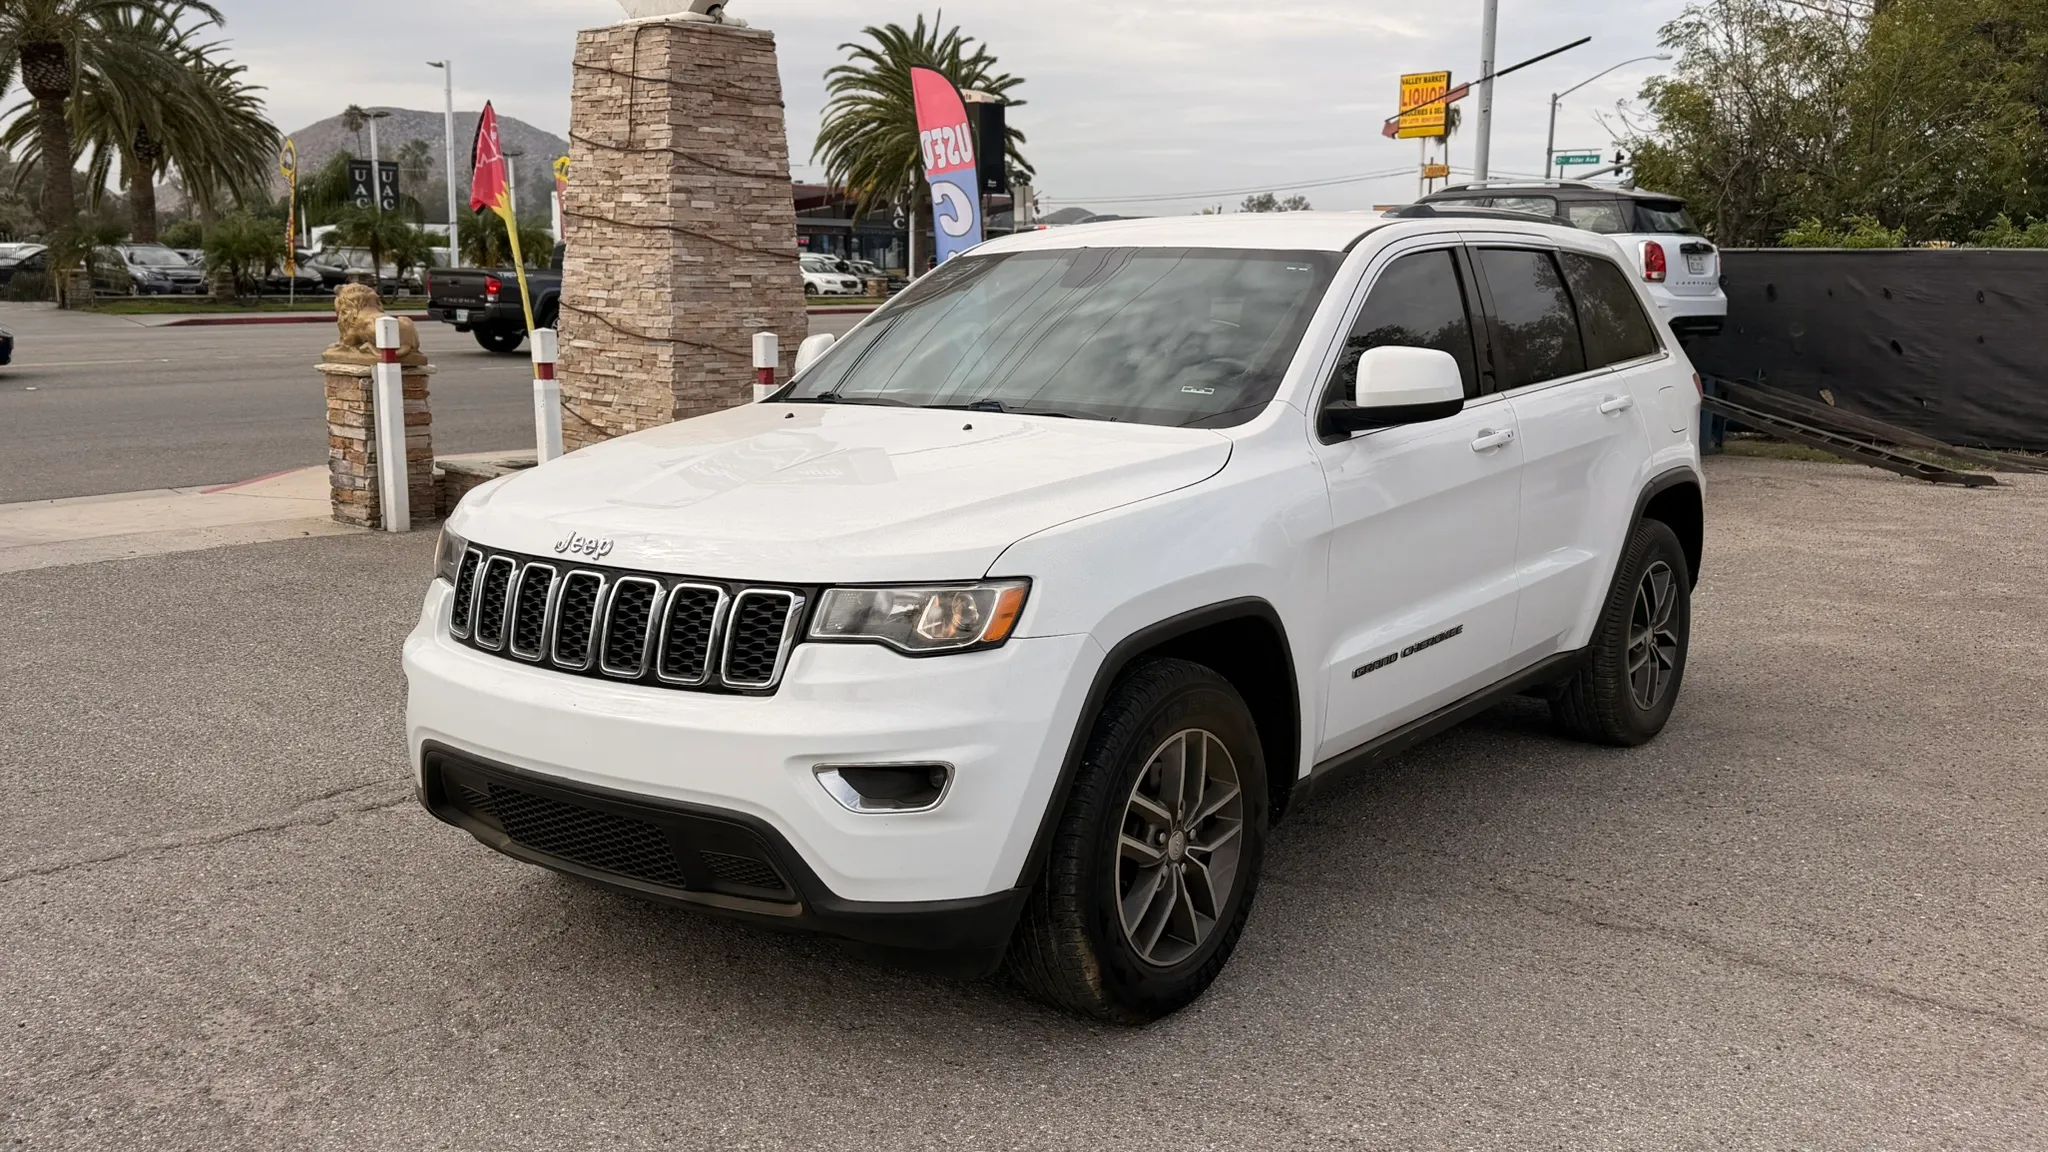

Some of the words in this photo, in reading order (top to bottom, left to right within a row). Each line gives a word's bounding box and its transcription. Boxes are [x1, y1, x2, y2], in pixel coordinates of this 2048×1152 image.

[1401, 77, 1422, 85] VALLEY
[1423, 74, 1446, 84] MARKET
[1401, 86, 1446, 107] LIQUOR
[354, 169, 369, 210] UAC
[381, 171, 395, 211] UAC
[554, 529, 614, 561] Jeep
[1351, 651, 1399, 679] GRAND
[1400, 623, 1464, 659] CHEROKEE
